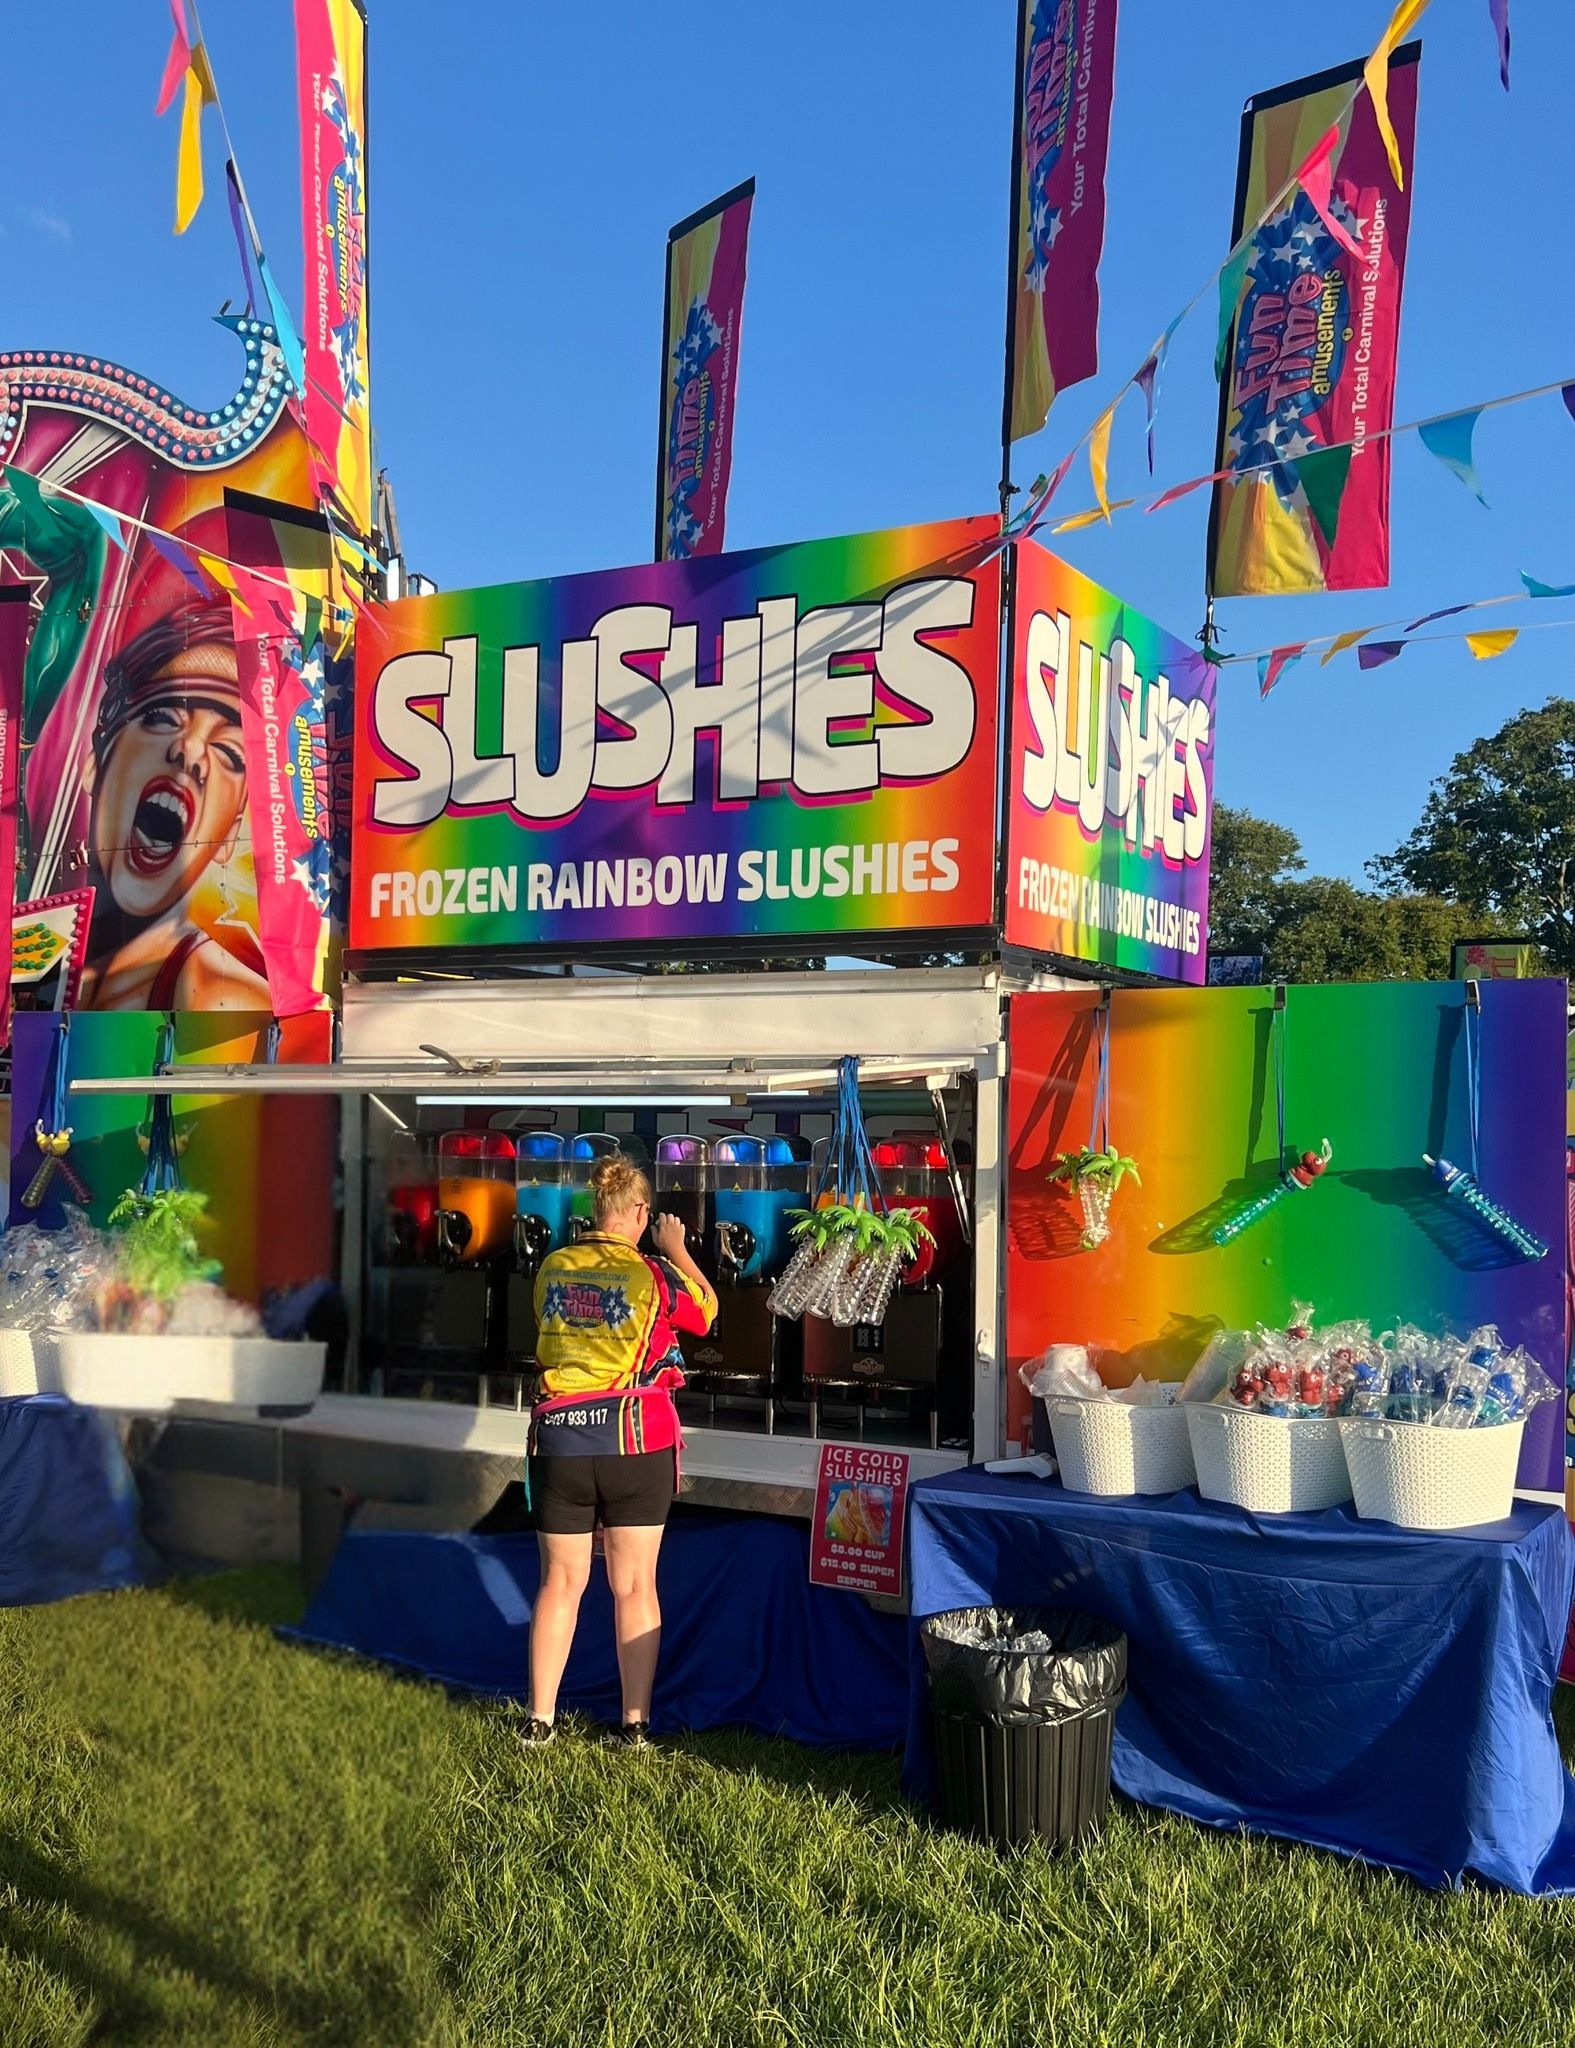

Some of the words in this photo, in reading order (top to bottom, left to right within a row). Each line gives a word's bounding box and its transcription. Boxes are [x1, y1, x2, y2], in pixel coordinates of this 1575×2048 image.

[312, 73, 321, 117] Your
[1073, 92, 1089, 157] Total
[314, 175, 328, 260] Carnival
[1071, 160, 1085, 217] Your
[333, 174, 348, 314] amusements
[1363, 199, 1388, 282] Solutions
[317, 260, 329, 351] Solutions
[1311, 269, 1345, 395] amusements
[1355, 284, 1377, 363] Carnival
[721, 308, 733, 381] Solutions
[1232, 292, 1286, 411] Fun
[1265, 272, 1324, 416] Time
[694, 370, 711, 480] amusements
[714, 382, 728, 449] Carnival
[1352, 366, 1369, 413] Total
[710, 451, 722, 492] Total
[1351, 416, 1366, 457] Your
[707, 493, 718, 529] Your
[257, 632, 271, 672] Your
[261, 675, 279, 720] Total
[370, 575, 979, 829] SLUSHIES
[265, 723, 285, 799] Carnival
[1021, 607, 1211, 865] SLUSHIES
[294, 714, 320, 839] amusements
[270, 803, 289, 884] Solutions
[370, 865, 518, 918] FROZEN
[527, 853, 728, 911] RAINBOW
[737, 838, 960, 902] SLUSHIES
[1019, 856, 1079, 922] FROZEN
[1081, 875, 1145, 940] RAINBOW
[1145, 896, 1201, 955] SLUSHIES
[561, 1298, 605, 1318] Time
[566, 1283, 601, 1305] Fun
[567, 1410, 587, 1426] 933
[590, 1408, 608, 1425] 117
[824, 1463, 902, 1486] SLUSHIES
[827, 1447, 853, 1463] ICE
[858, 1452, 903, 1470] COLD
[864, 1549, 886, 1560] CUP
